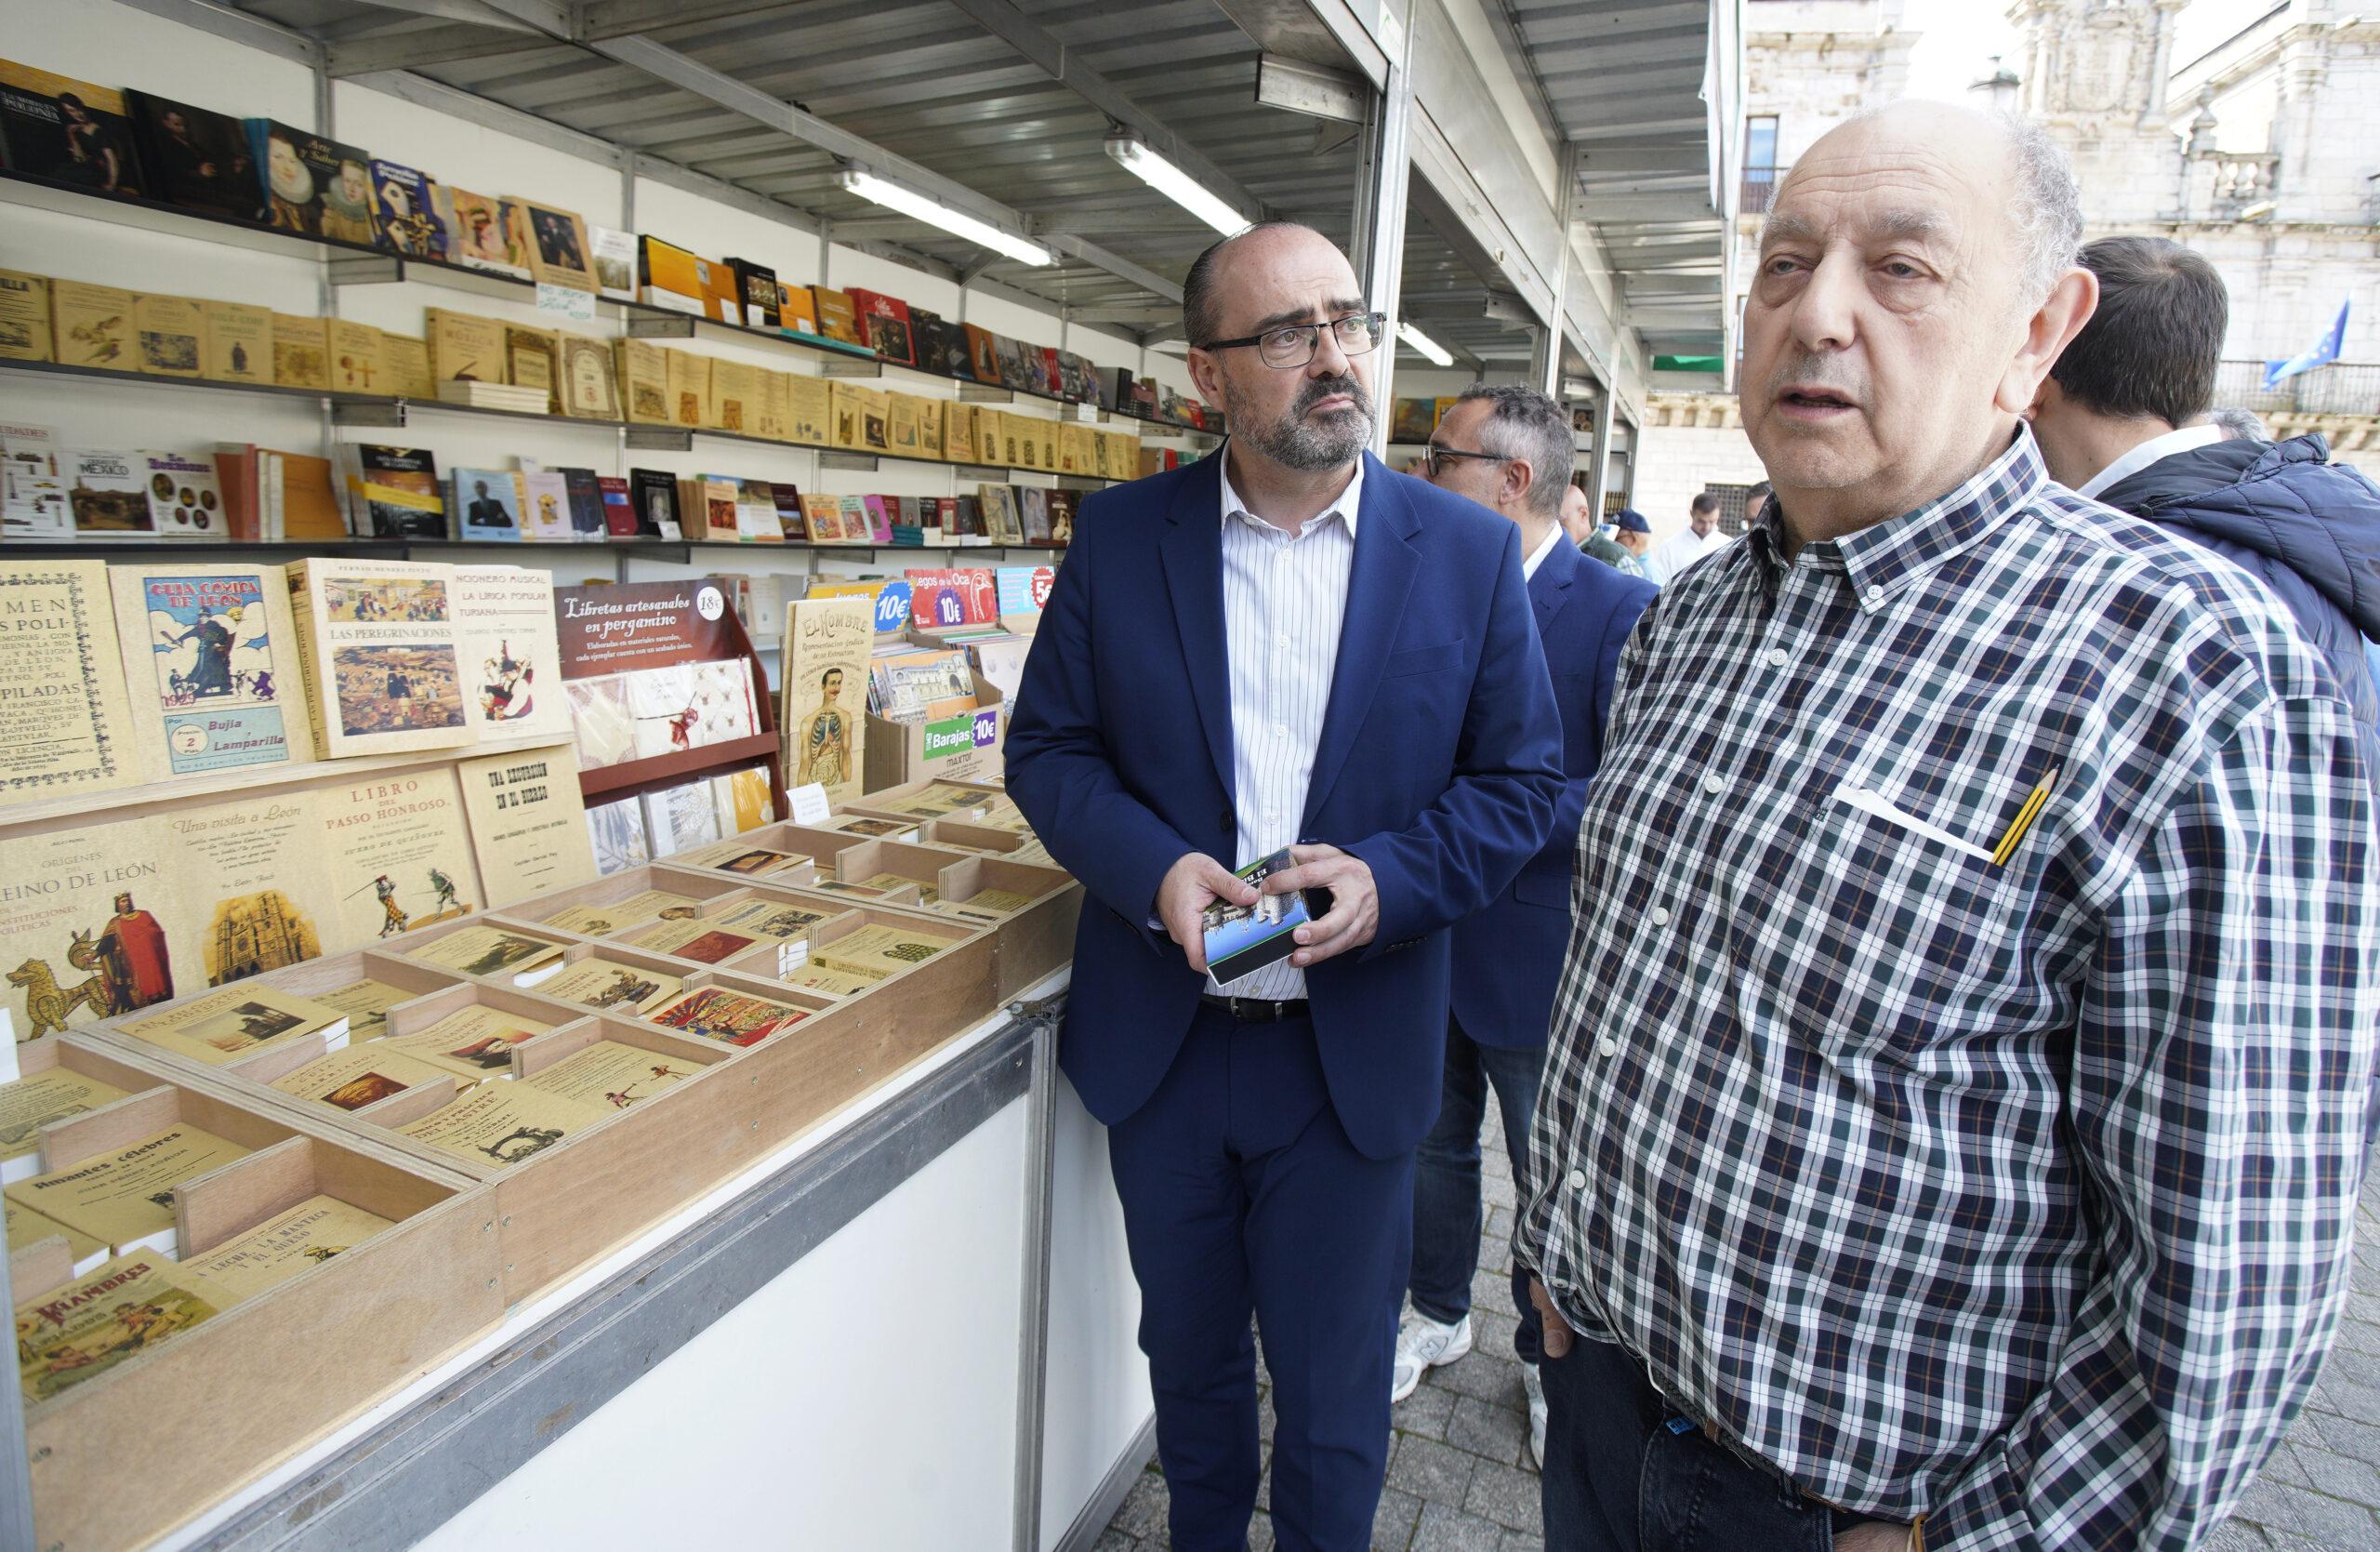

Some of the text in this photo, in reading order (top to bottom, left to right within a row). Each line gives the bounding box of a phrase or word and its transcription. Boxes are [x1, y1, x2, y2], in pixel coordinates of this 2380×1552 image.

[952, 572, 970, 587] Oca
[168, 595, 193, 607] DE
[563, 597, 622, 618] Libretas
[625, 593, 690, 614] artesanales
[878, 594, 908, 621] 10€
[940, 596, 961, 623] 10€
[330, 628, 452, 640] LAS PEREGRINACIONES
[585, 611, 677, 640] en pergamino
[1, 683, 81, 700] PILADAS
[932, 729, 971, 749] Barajas
[975, 719, 995, 740] 10€
[350, 780, 418, 803] LIBRO
[172, 804, 301, 834] Una visita a León
[325, 813, 372, 829] PASSO
[69, 873, 97, 889] DE
[104, 862, 157, 883] LEÓN
[32, 1161, 112, 1190] Amantes
[279, 1209, 331, 1238] MANTECA
[272, 1230, 312, 1253] QUESO
